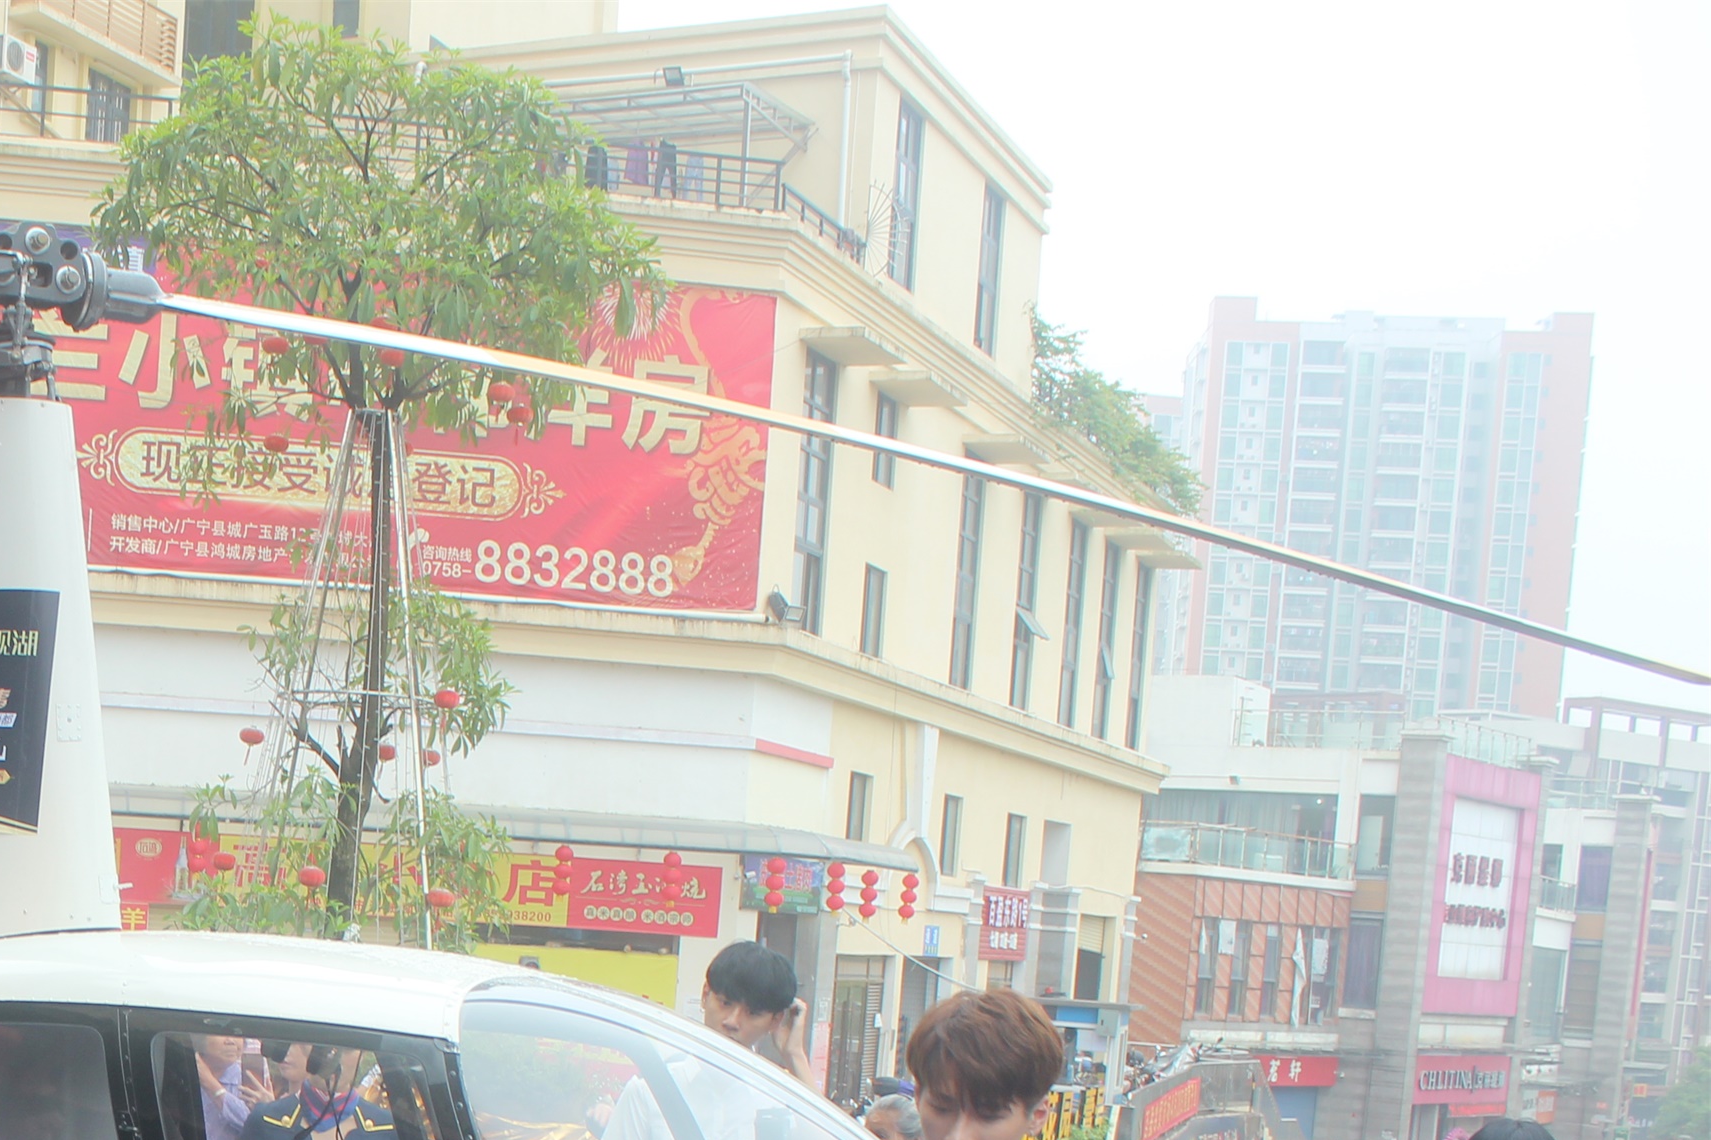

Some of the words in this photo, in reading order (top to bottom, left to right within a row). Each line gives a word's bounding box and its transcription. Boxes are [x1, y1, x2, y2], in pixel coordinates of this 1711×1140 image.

[141, 439, 497, 508] 现在接受诚登记
[422, 544, 472, 563] 咨询热线
[475, 540, 674, 597] 8832888
[580, 869, 707, 900] 石湾玉烧
[1419, 1070, 1473, 1091] CHLITINA
